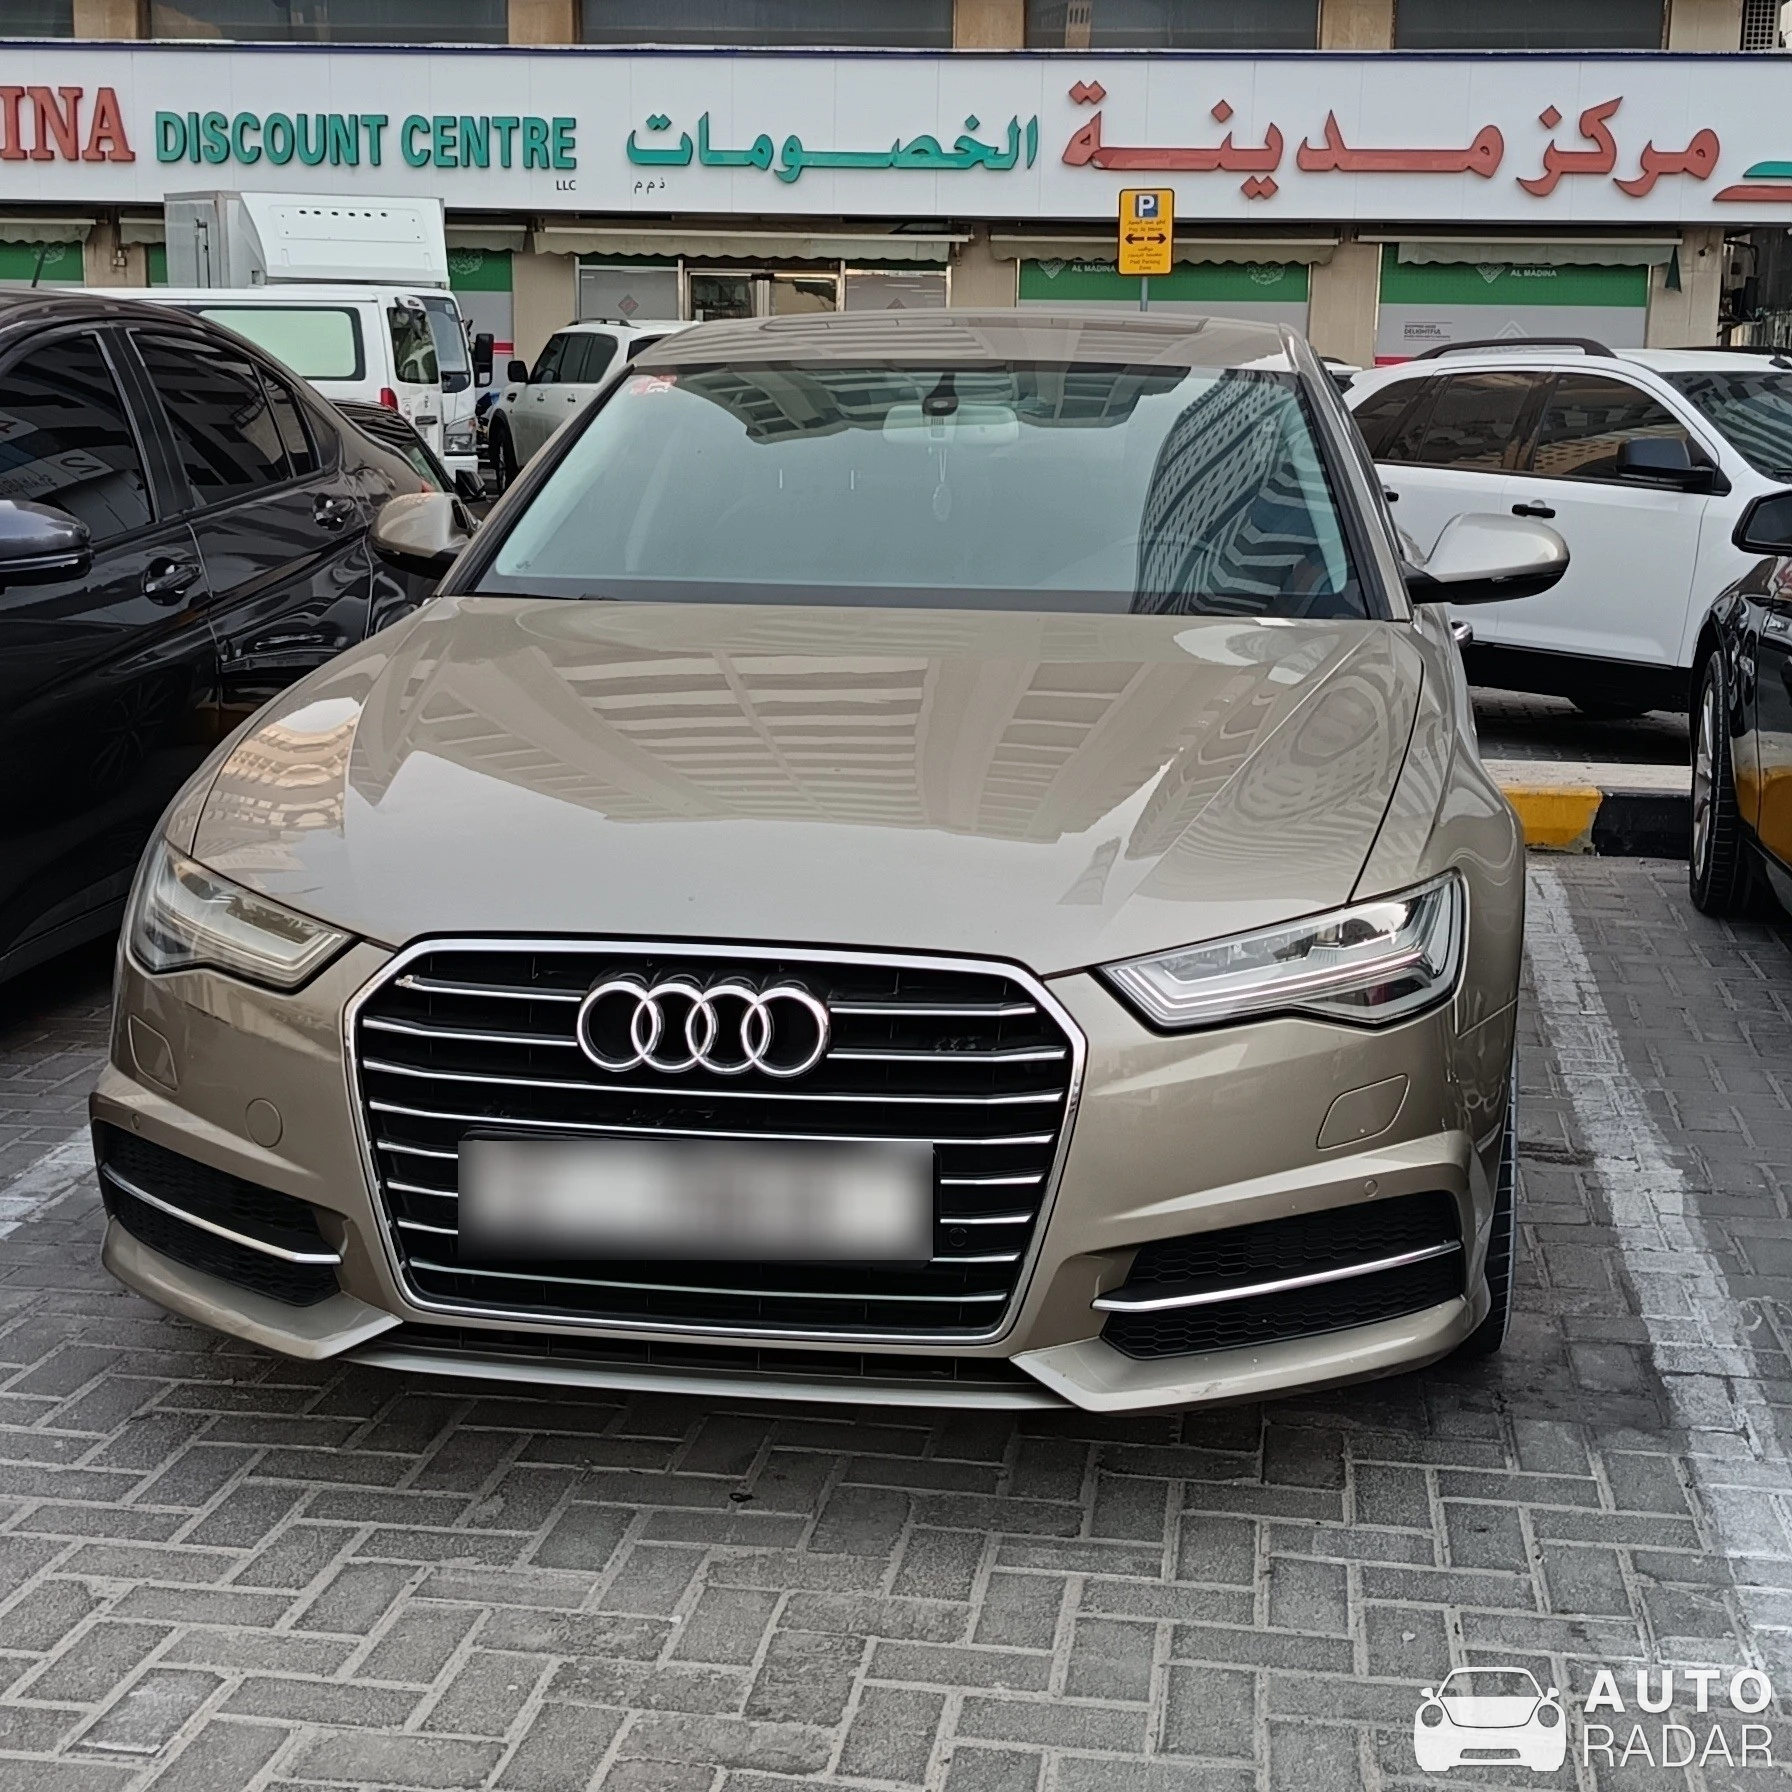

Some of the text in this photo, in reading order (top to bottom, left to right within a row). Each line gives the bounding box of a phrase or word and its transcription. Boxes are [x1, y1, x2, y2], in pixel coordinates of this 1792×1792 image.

[0, 86, 577, 170] INA DISCOUNT CENTRE
[626, 80, 1720, 200] مركز مدينة الخصومات
[556, 179, 577, 191] LLC
[1138, 194, 1155, 217] P
[1071, 264, 1116, 273] AL MADINA
[1510, 269, 1558, 277] AL MADINA
